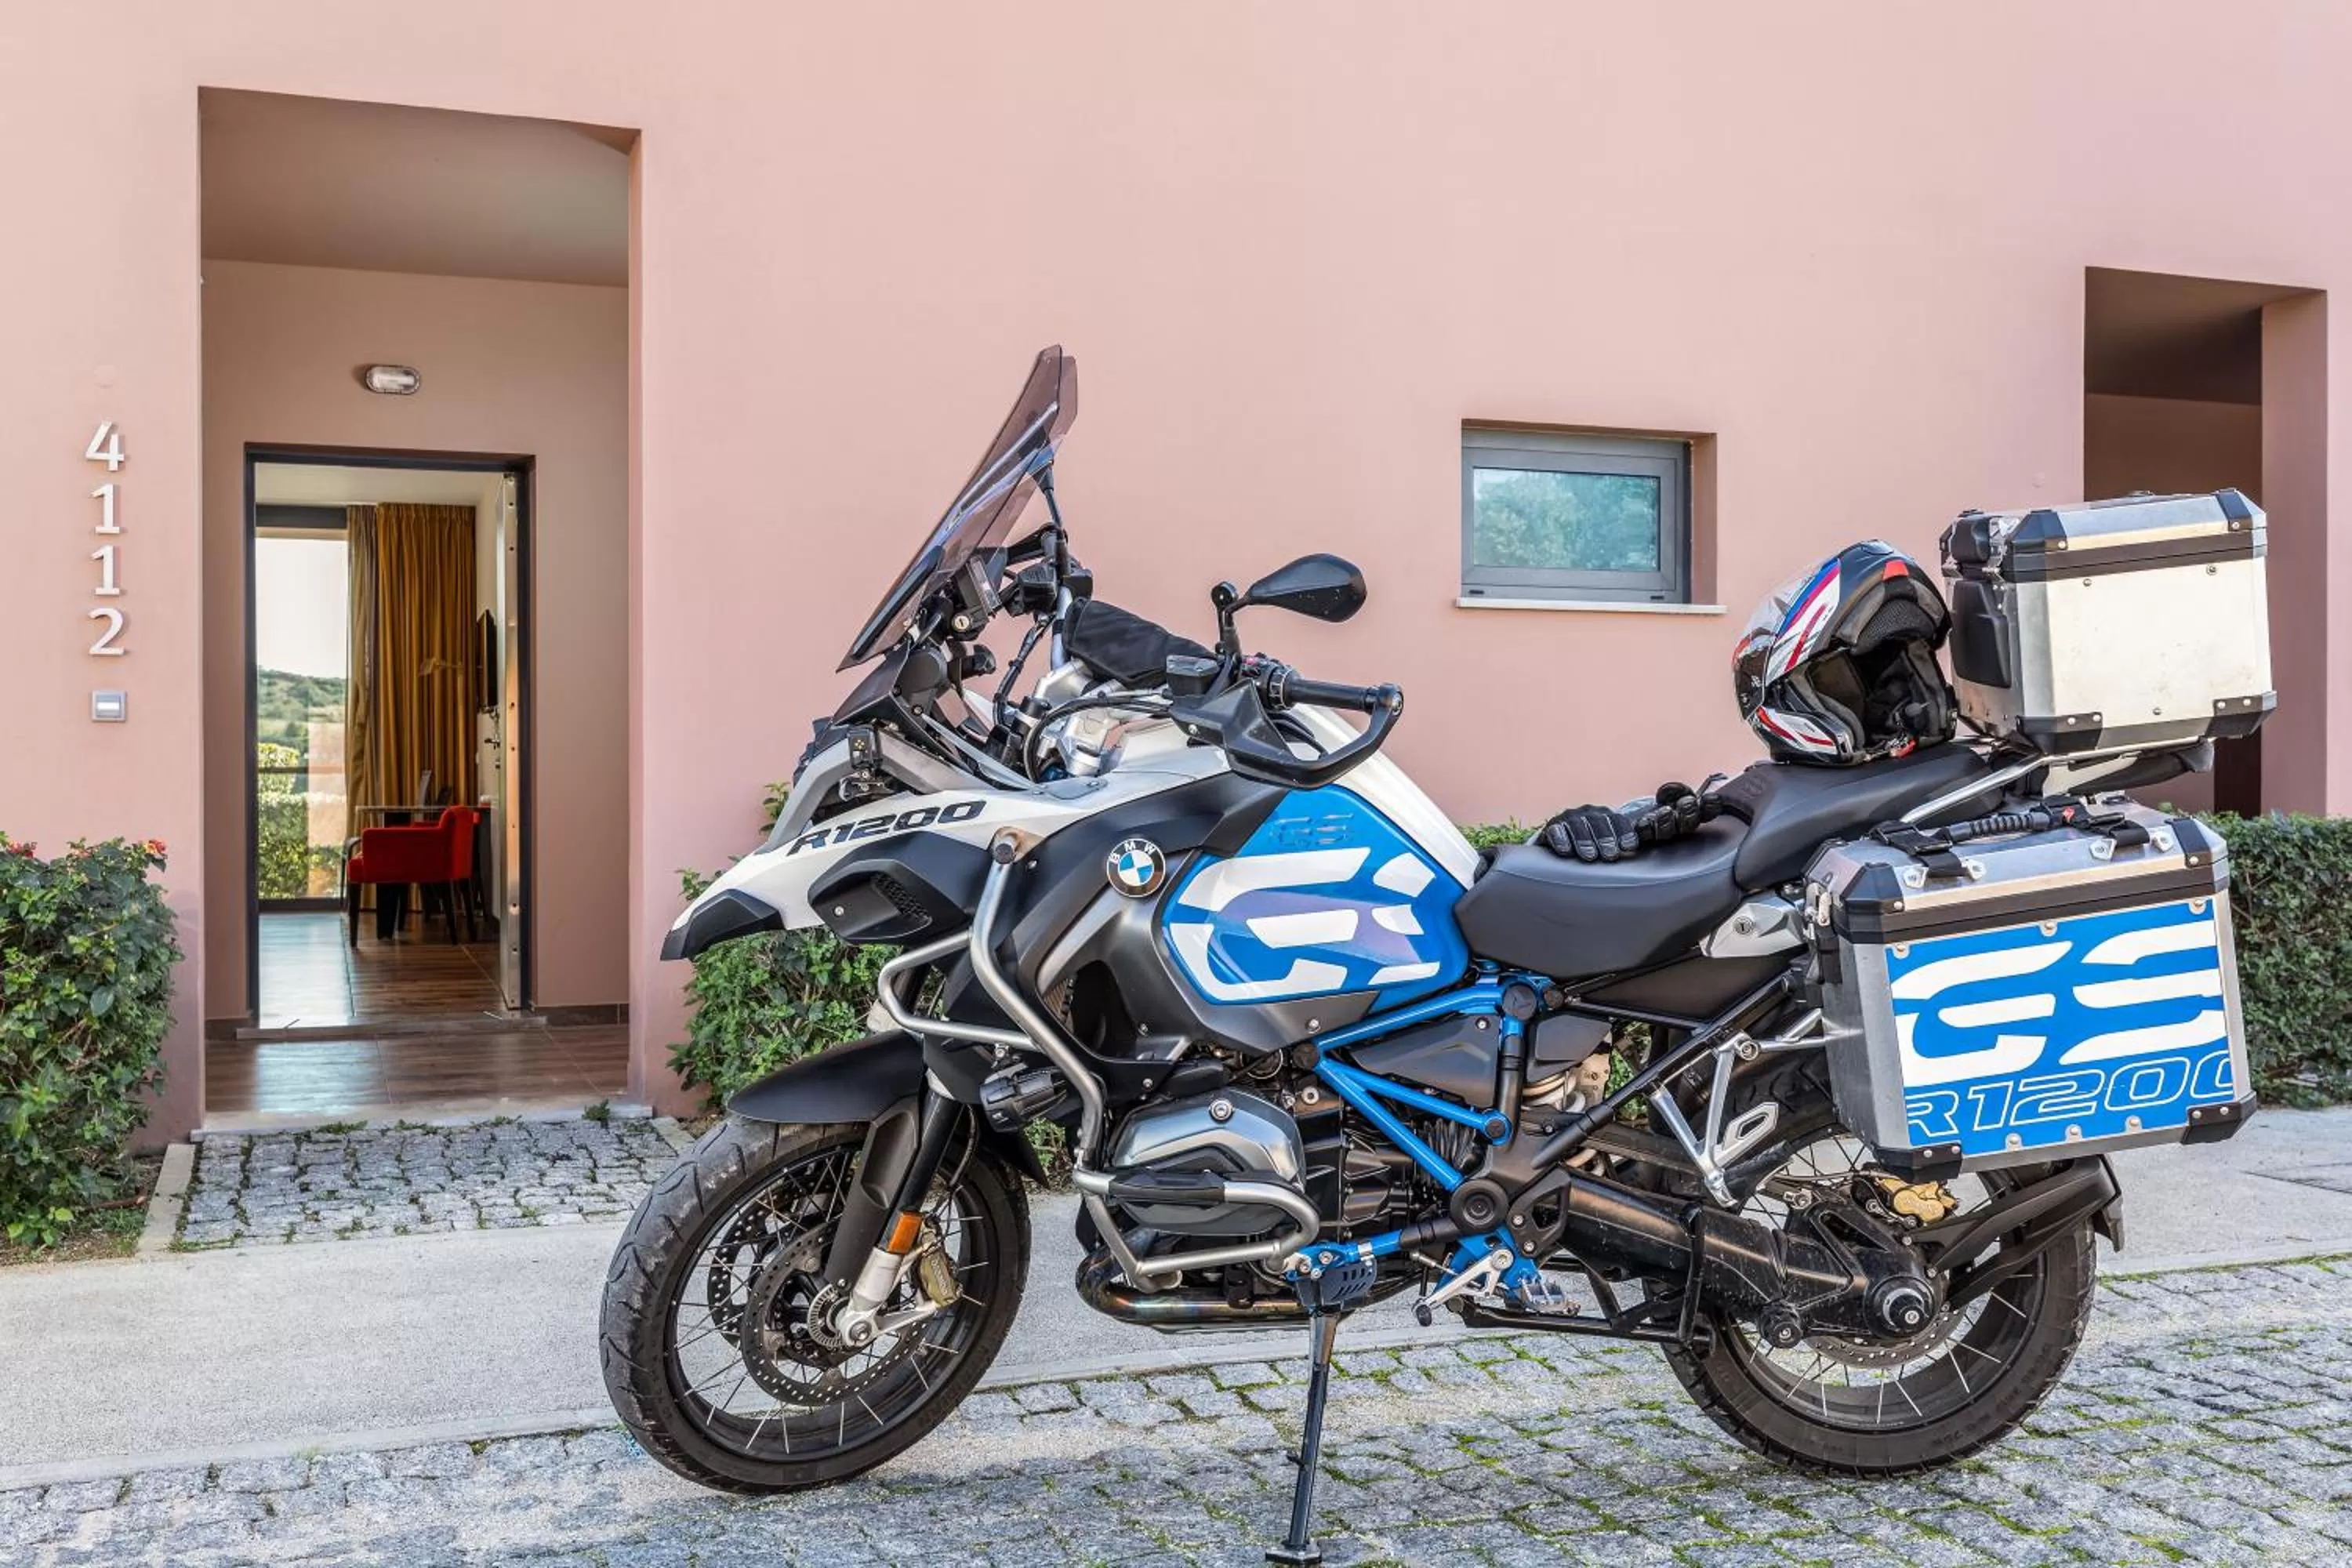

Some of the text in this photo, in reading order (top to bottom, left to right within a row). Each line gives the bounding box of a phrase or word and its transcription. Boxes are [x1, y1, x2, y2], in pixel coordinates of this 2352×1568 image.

[85, 419, 126, 657] 4112
[786, 800, 988, 857] R1200
[1108, 840, 1157, 865] BMW
